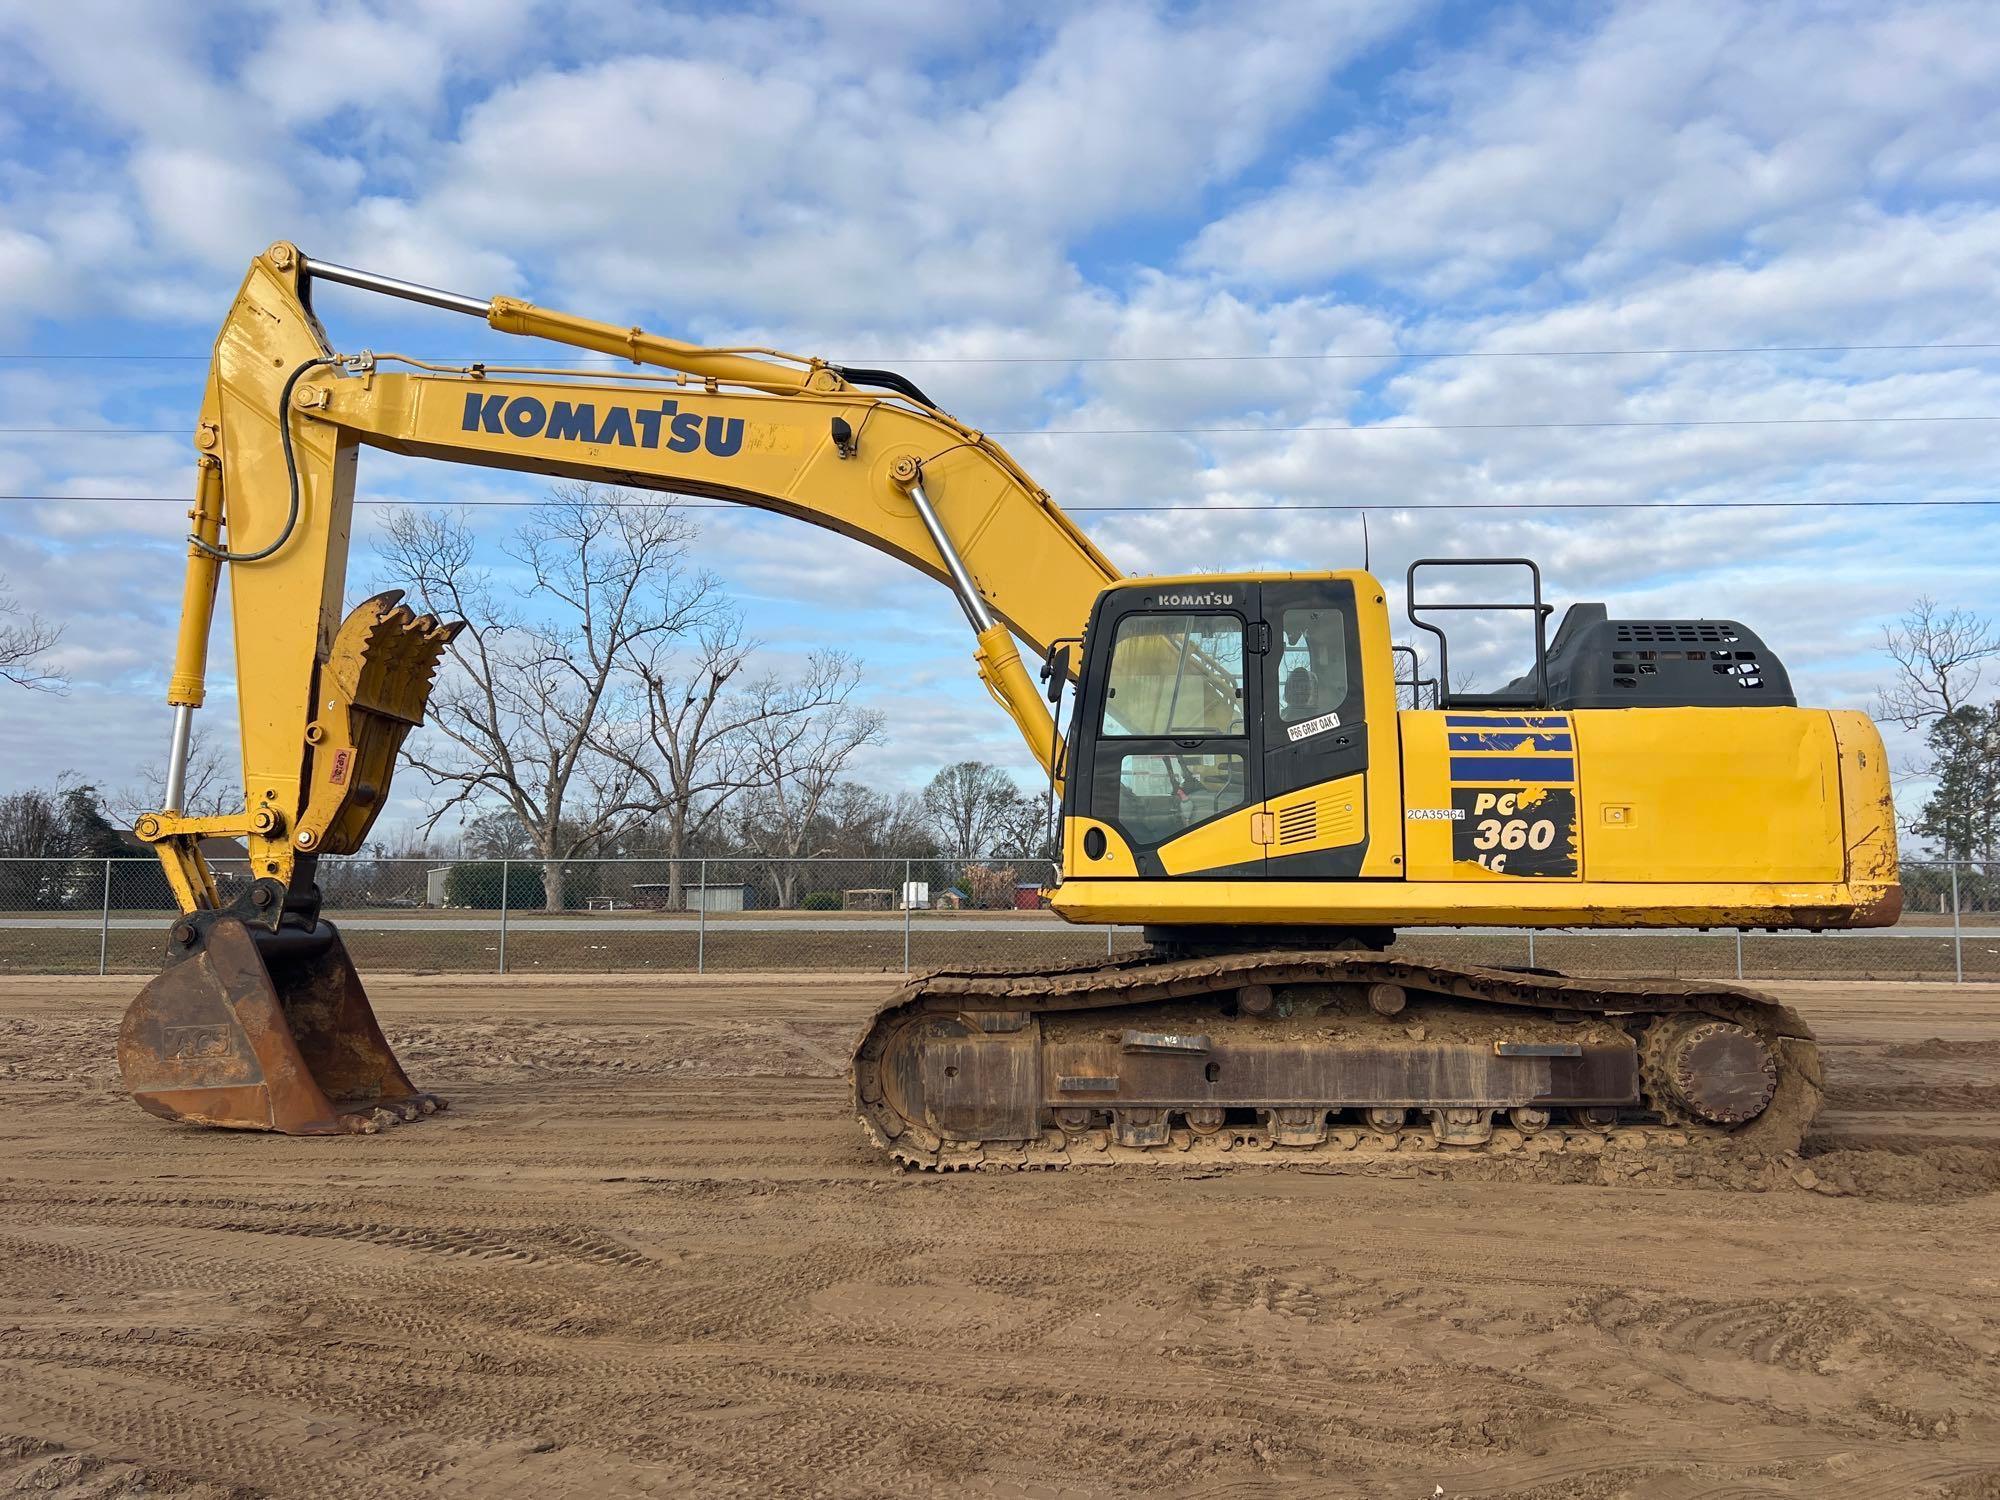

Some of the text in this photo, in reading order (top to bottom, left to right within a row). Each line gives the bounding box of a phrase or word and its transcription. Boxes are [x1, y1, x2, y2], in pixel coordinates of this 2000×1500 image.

[461, 392, 745, 457] KOMATSU
[1158, 591, 1233, 605] KOMATSU
[1302, 720, 1319, 735] GRAY
[1319, 716, 1334, 729] OAK
[1474, 793, 1517, 815] PC
[1407, 809, 1464, 820] 2CA35964
[1473, 819, 1556, 850] 360
